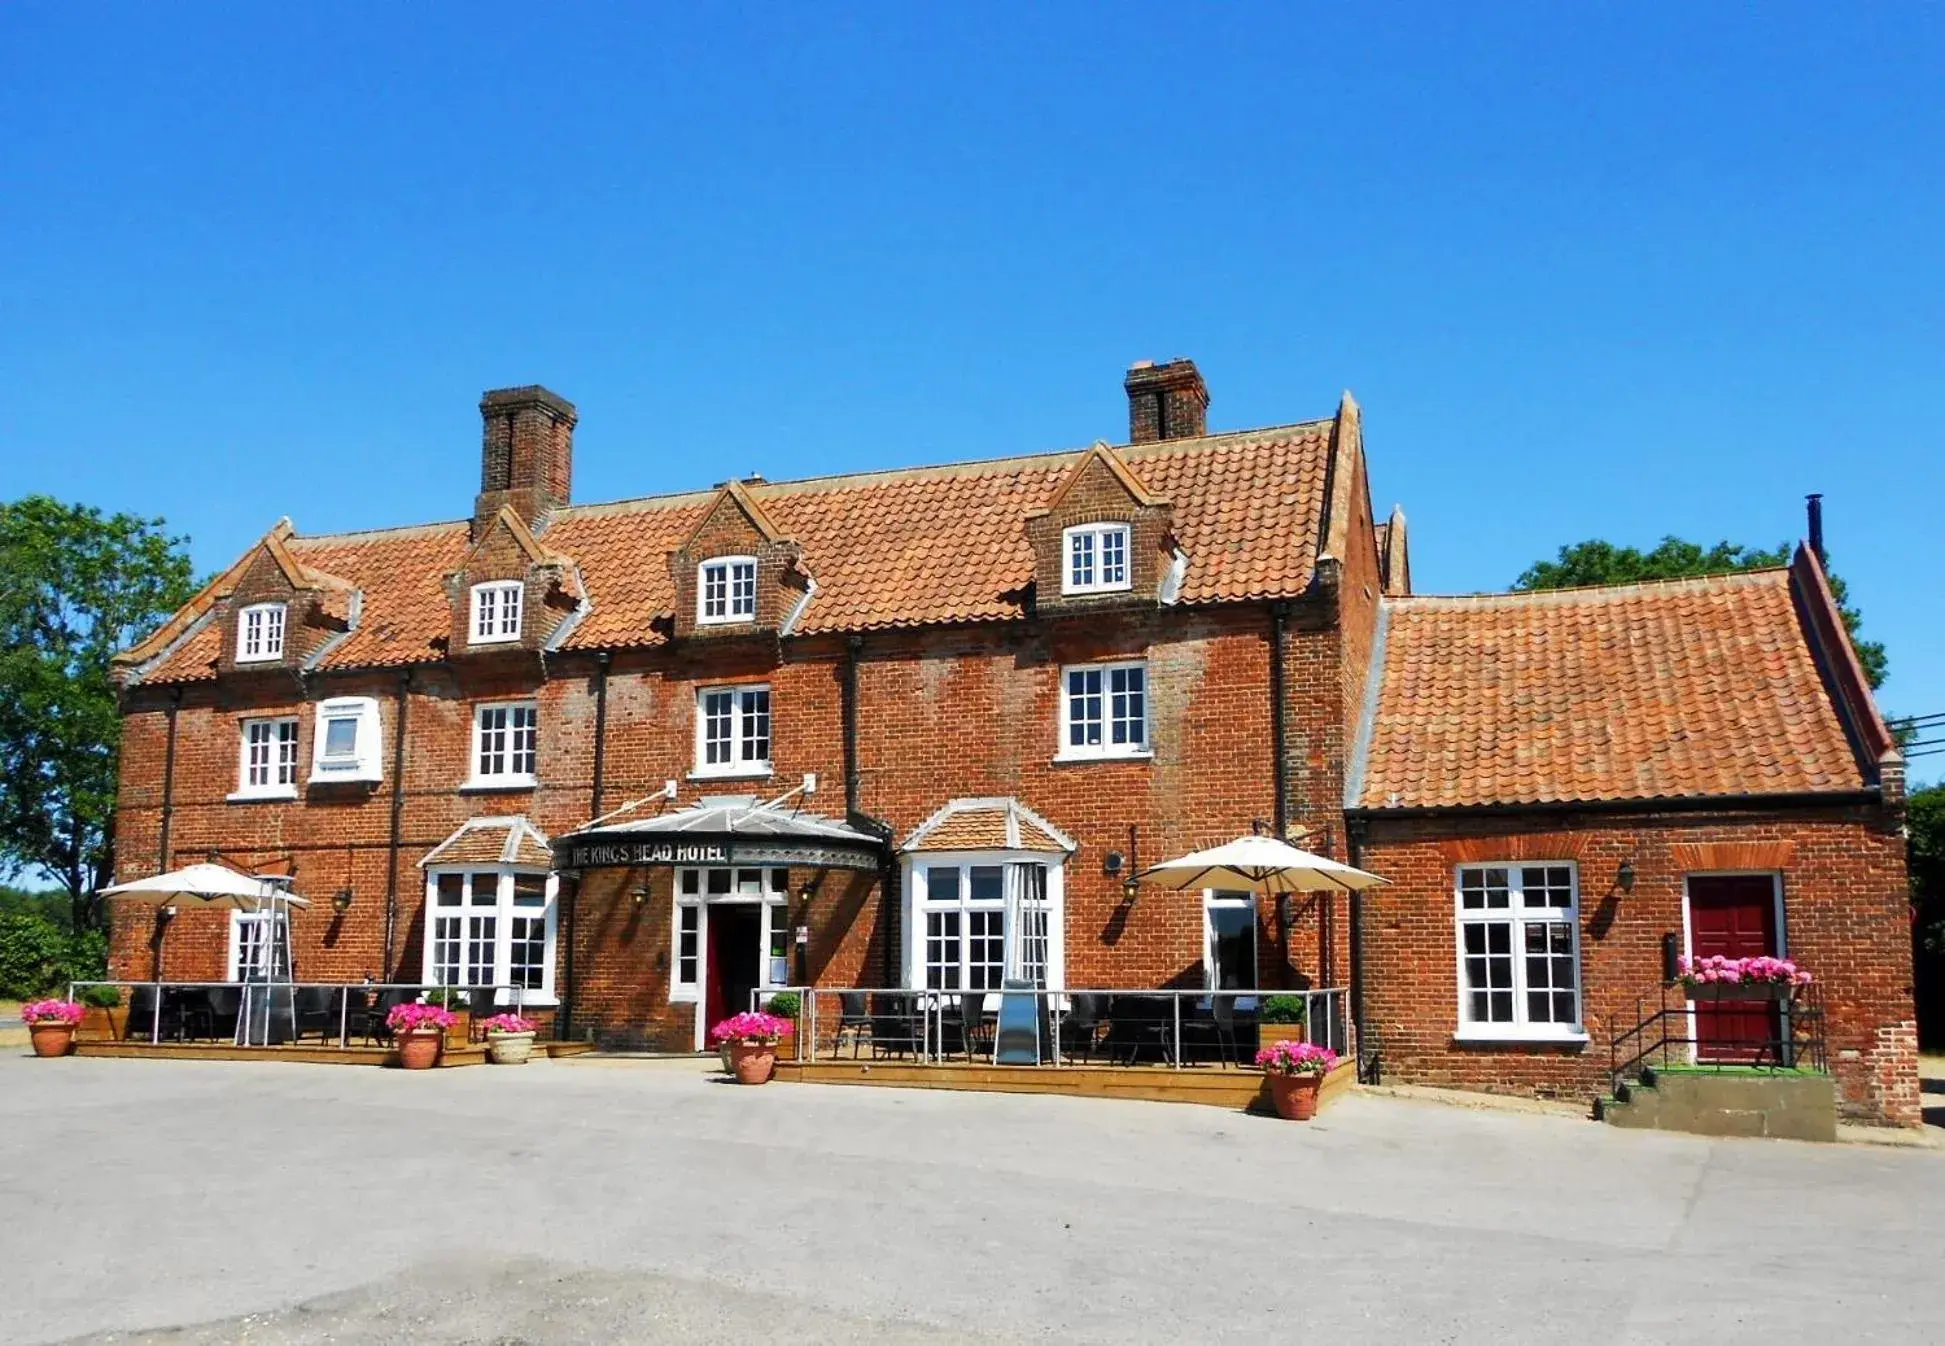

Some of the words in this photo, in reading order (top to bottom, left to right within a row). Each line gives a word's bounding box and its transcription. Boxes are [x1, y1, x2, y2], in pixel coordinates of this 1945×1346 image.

[572, 847, 588, 865] THE
[633, 843, 672, 861] HEAD
[677, 844, 725, 861] HOTEL
